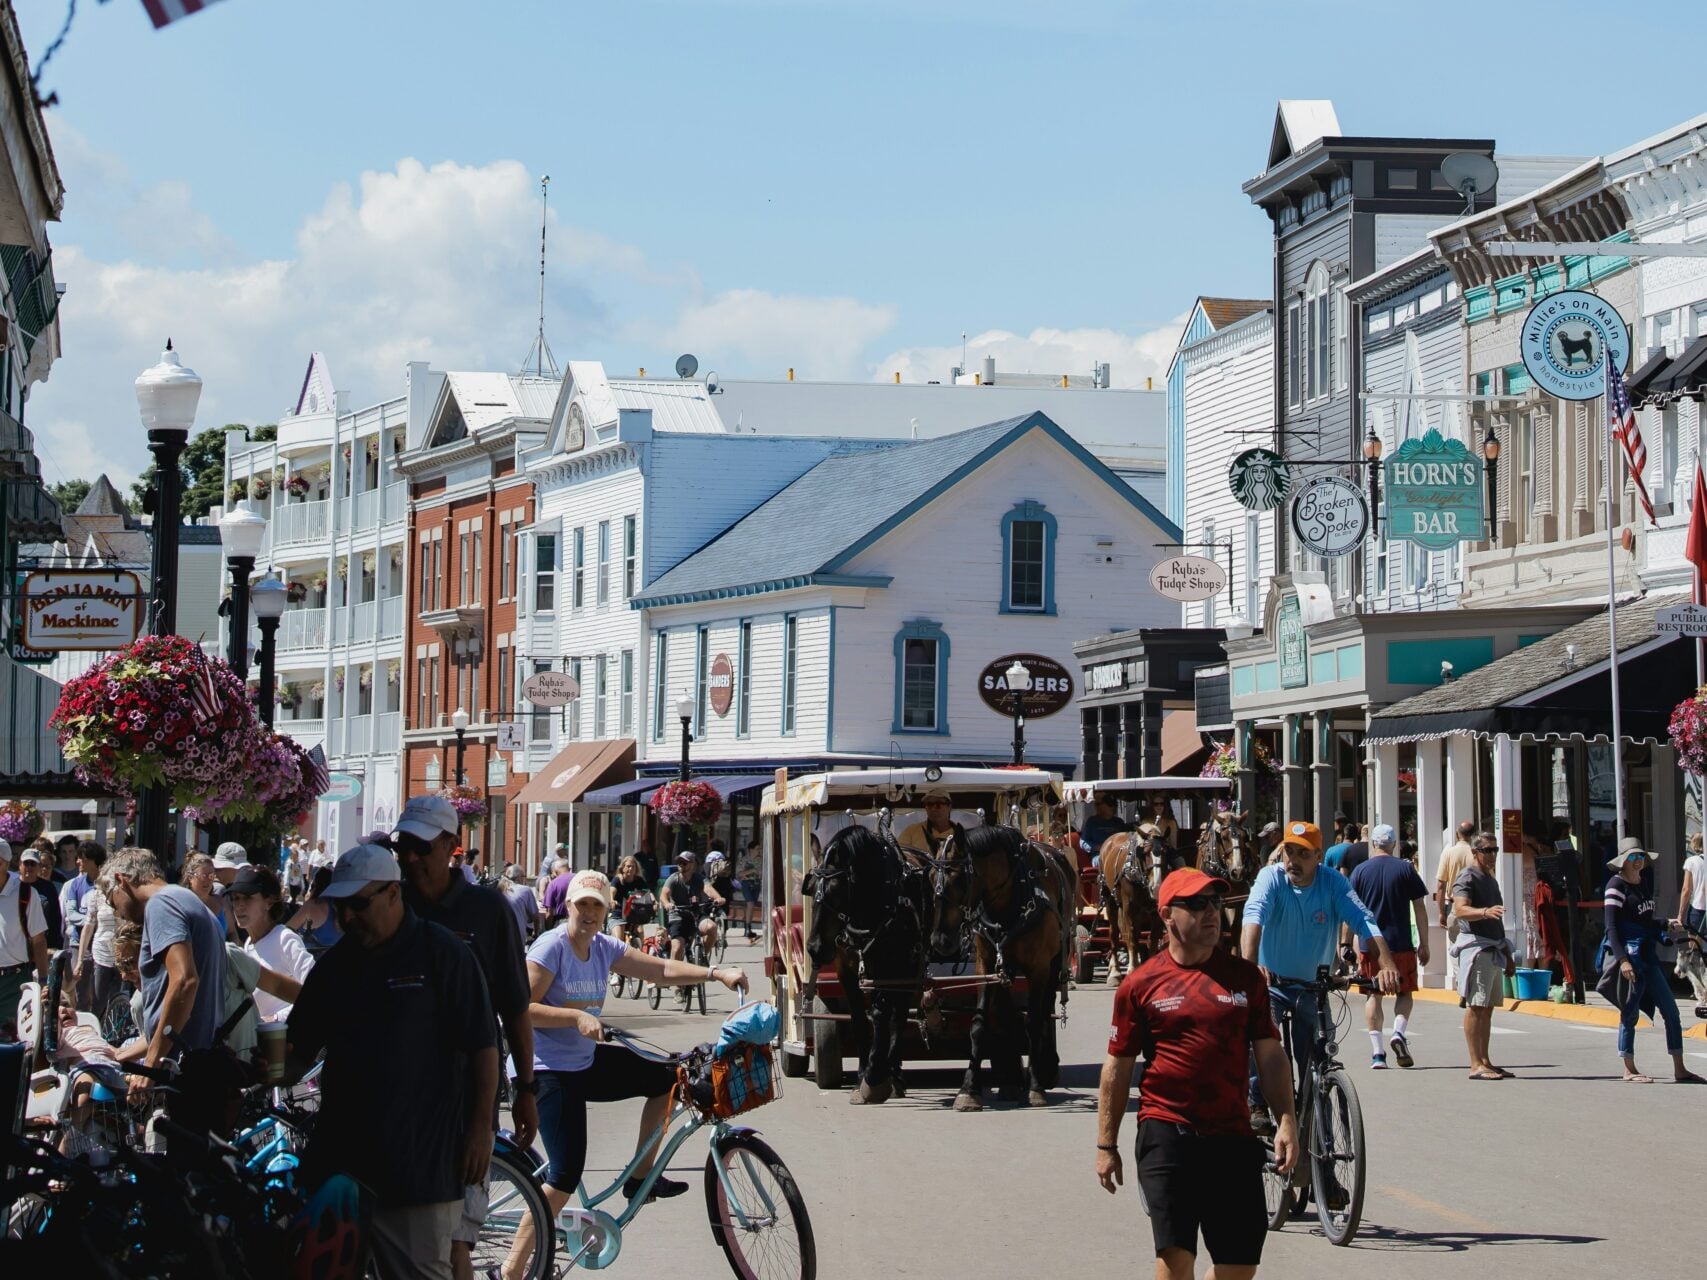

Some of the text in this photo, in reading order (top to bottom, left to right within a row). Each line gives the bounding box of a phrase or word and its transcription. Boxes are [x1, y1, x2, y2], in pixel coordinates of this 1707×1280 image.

[1529, 300, 1619, 343] Millie's on Main
[1540, 365, 1595, 392] homestyle
[1393, 462, 1476, 485] HORN'S
[1316, 487, 1333, 498] The
[1300, 490, 1354, 521] Broken
[1308, 509, 1359, 542] Spoke
[1413, 512, 1459, 534] BAR
[1172, 560, 1206, 578] Ryba's
[1156, 576, 1222, 593] Fudge Shops
[31, 583, 133, 612] BENJAMIN
[75, 601, 87, 611] of
[42, 614, 120, 628] Mackinac
[539, 675, 565, 689] Ryba's
[984, 675, 1069, 692] SADERS
[527, 687, 576, 700] Fudge Shops
